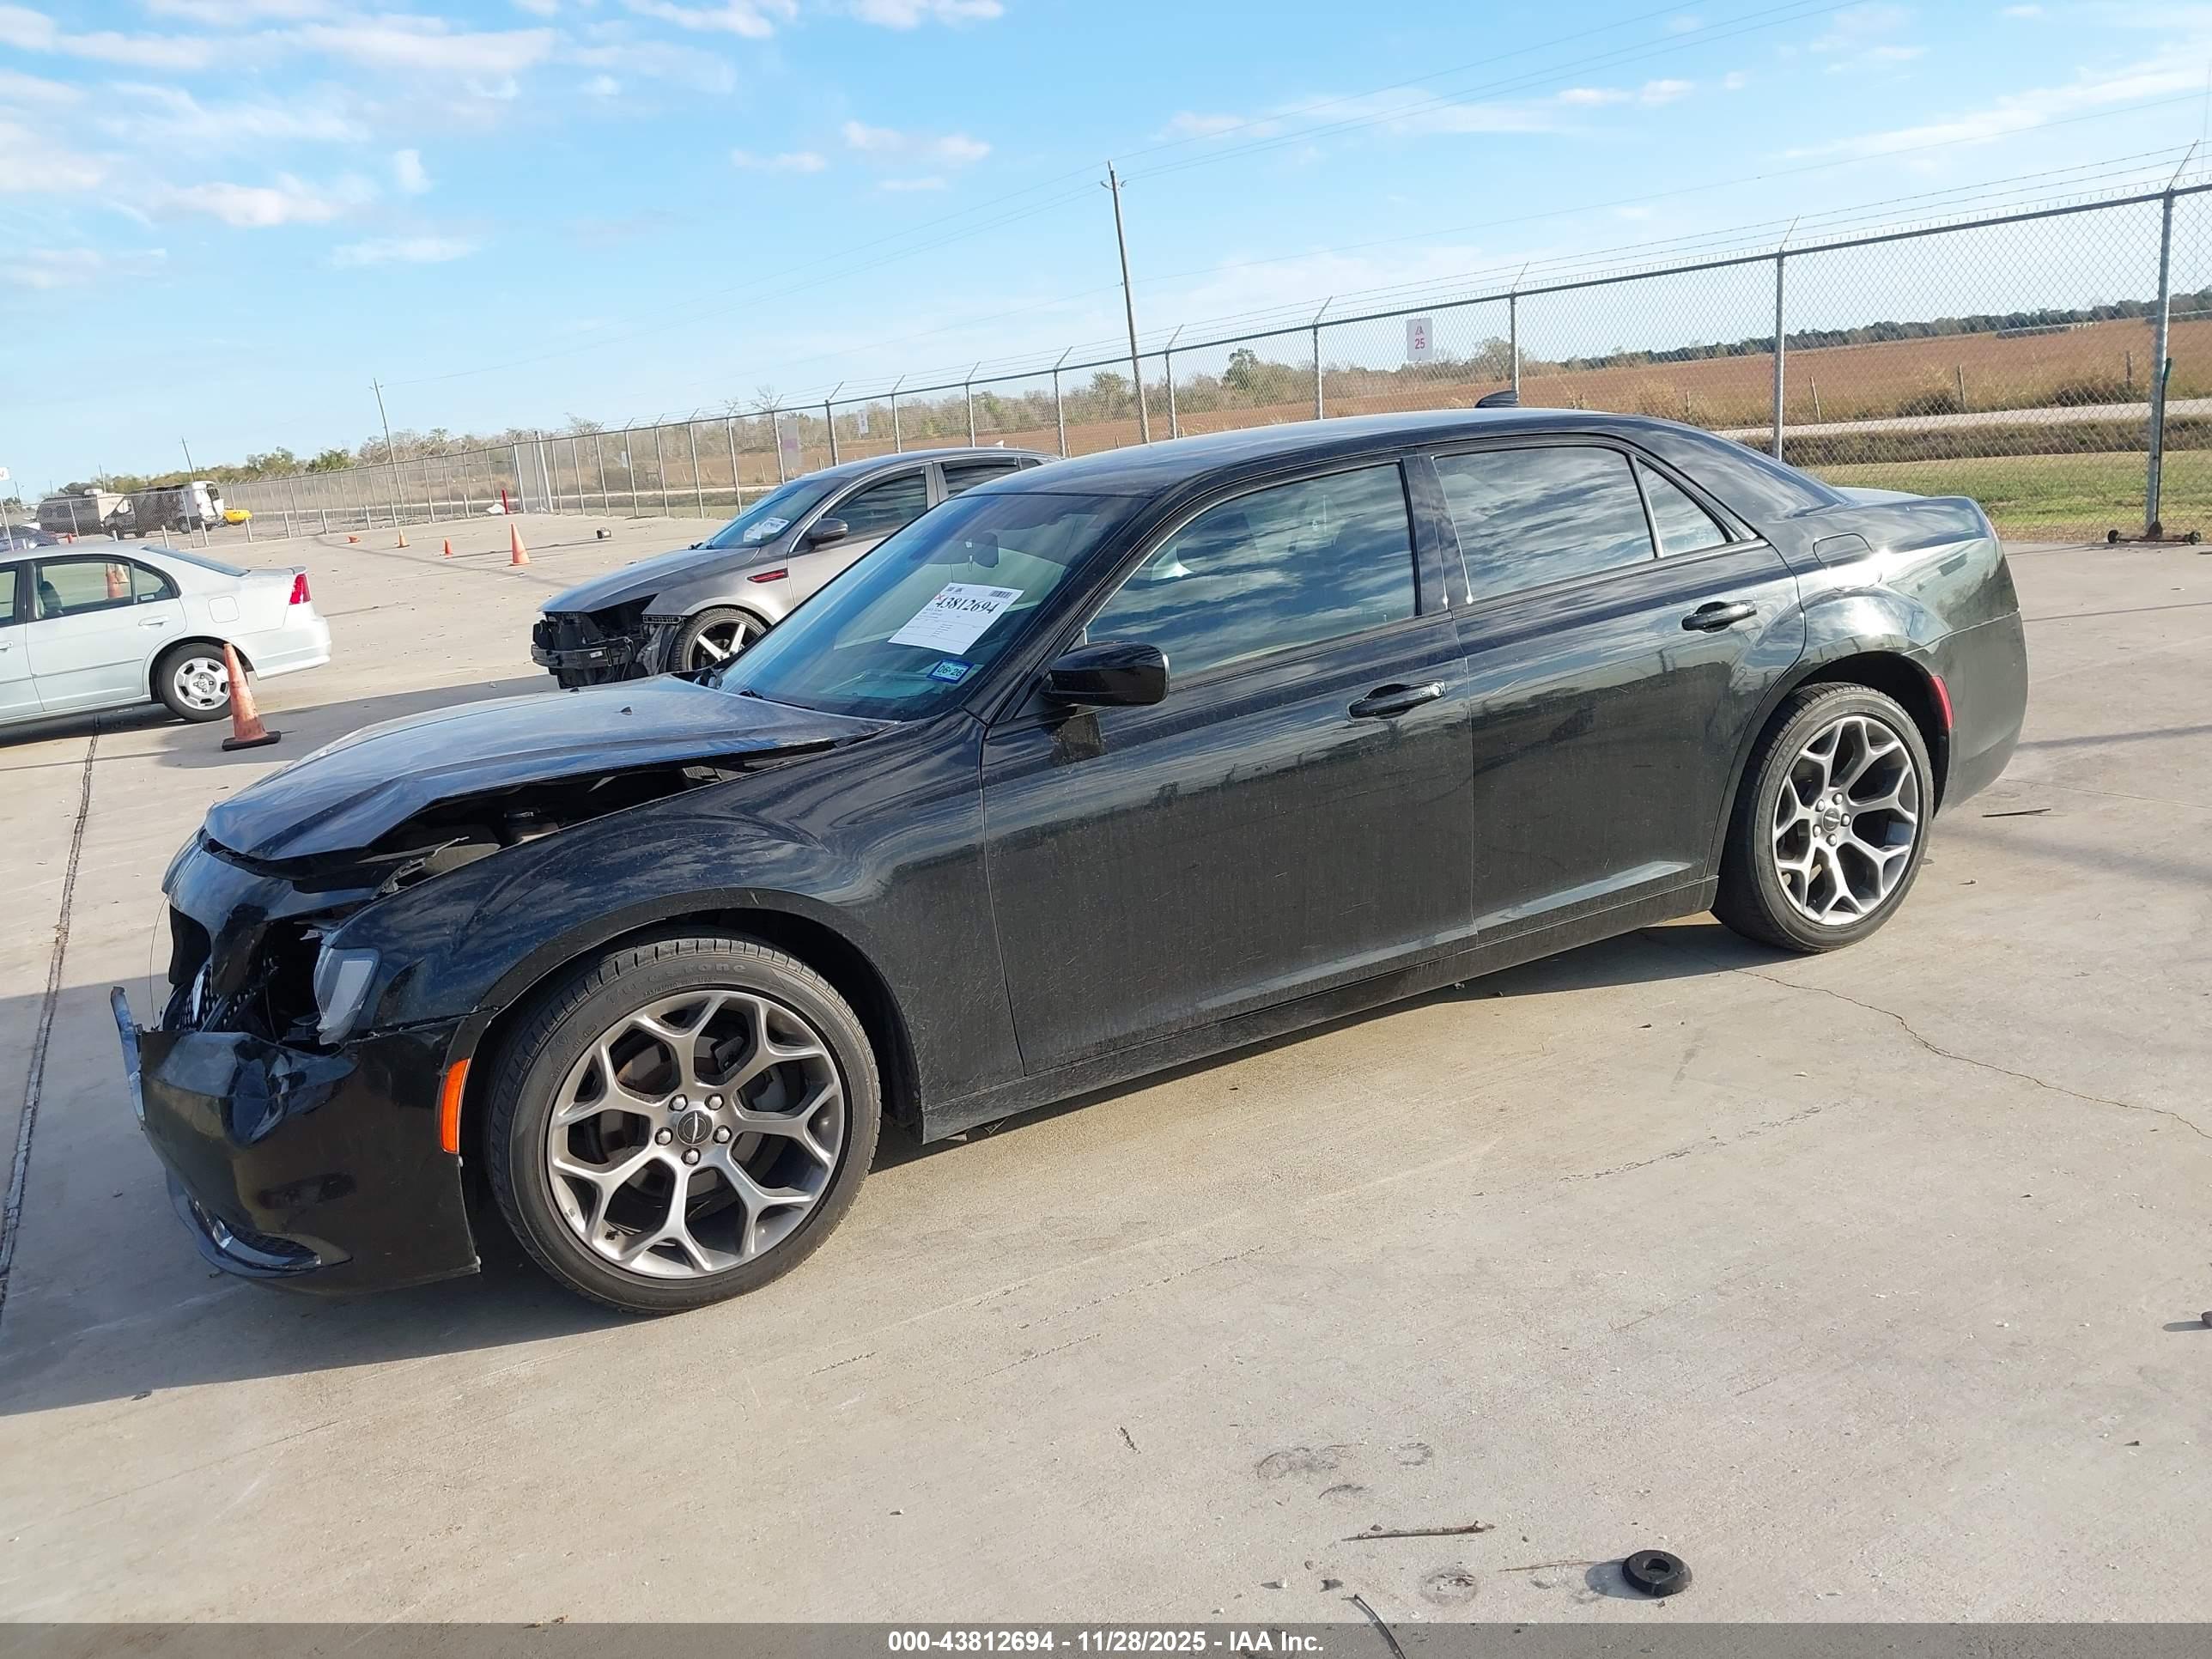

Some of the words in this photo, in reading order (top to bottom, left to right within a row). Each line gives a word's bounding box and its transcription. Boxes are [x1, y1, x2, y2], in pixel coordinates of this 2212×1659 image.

[1414, 337, 1425, 349] 25
[935, 597, 1000, 614] 43812694
[950, 668, 963, 677] 26
